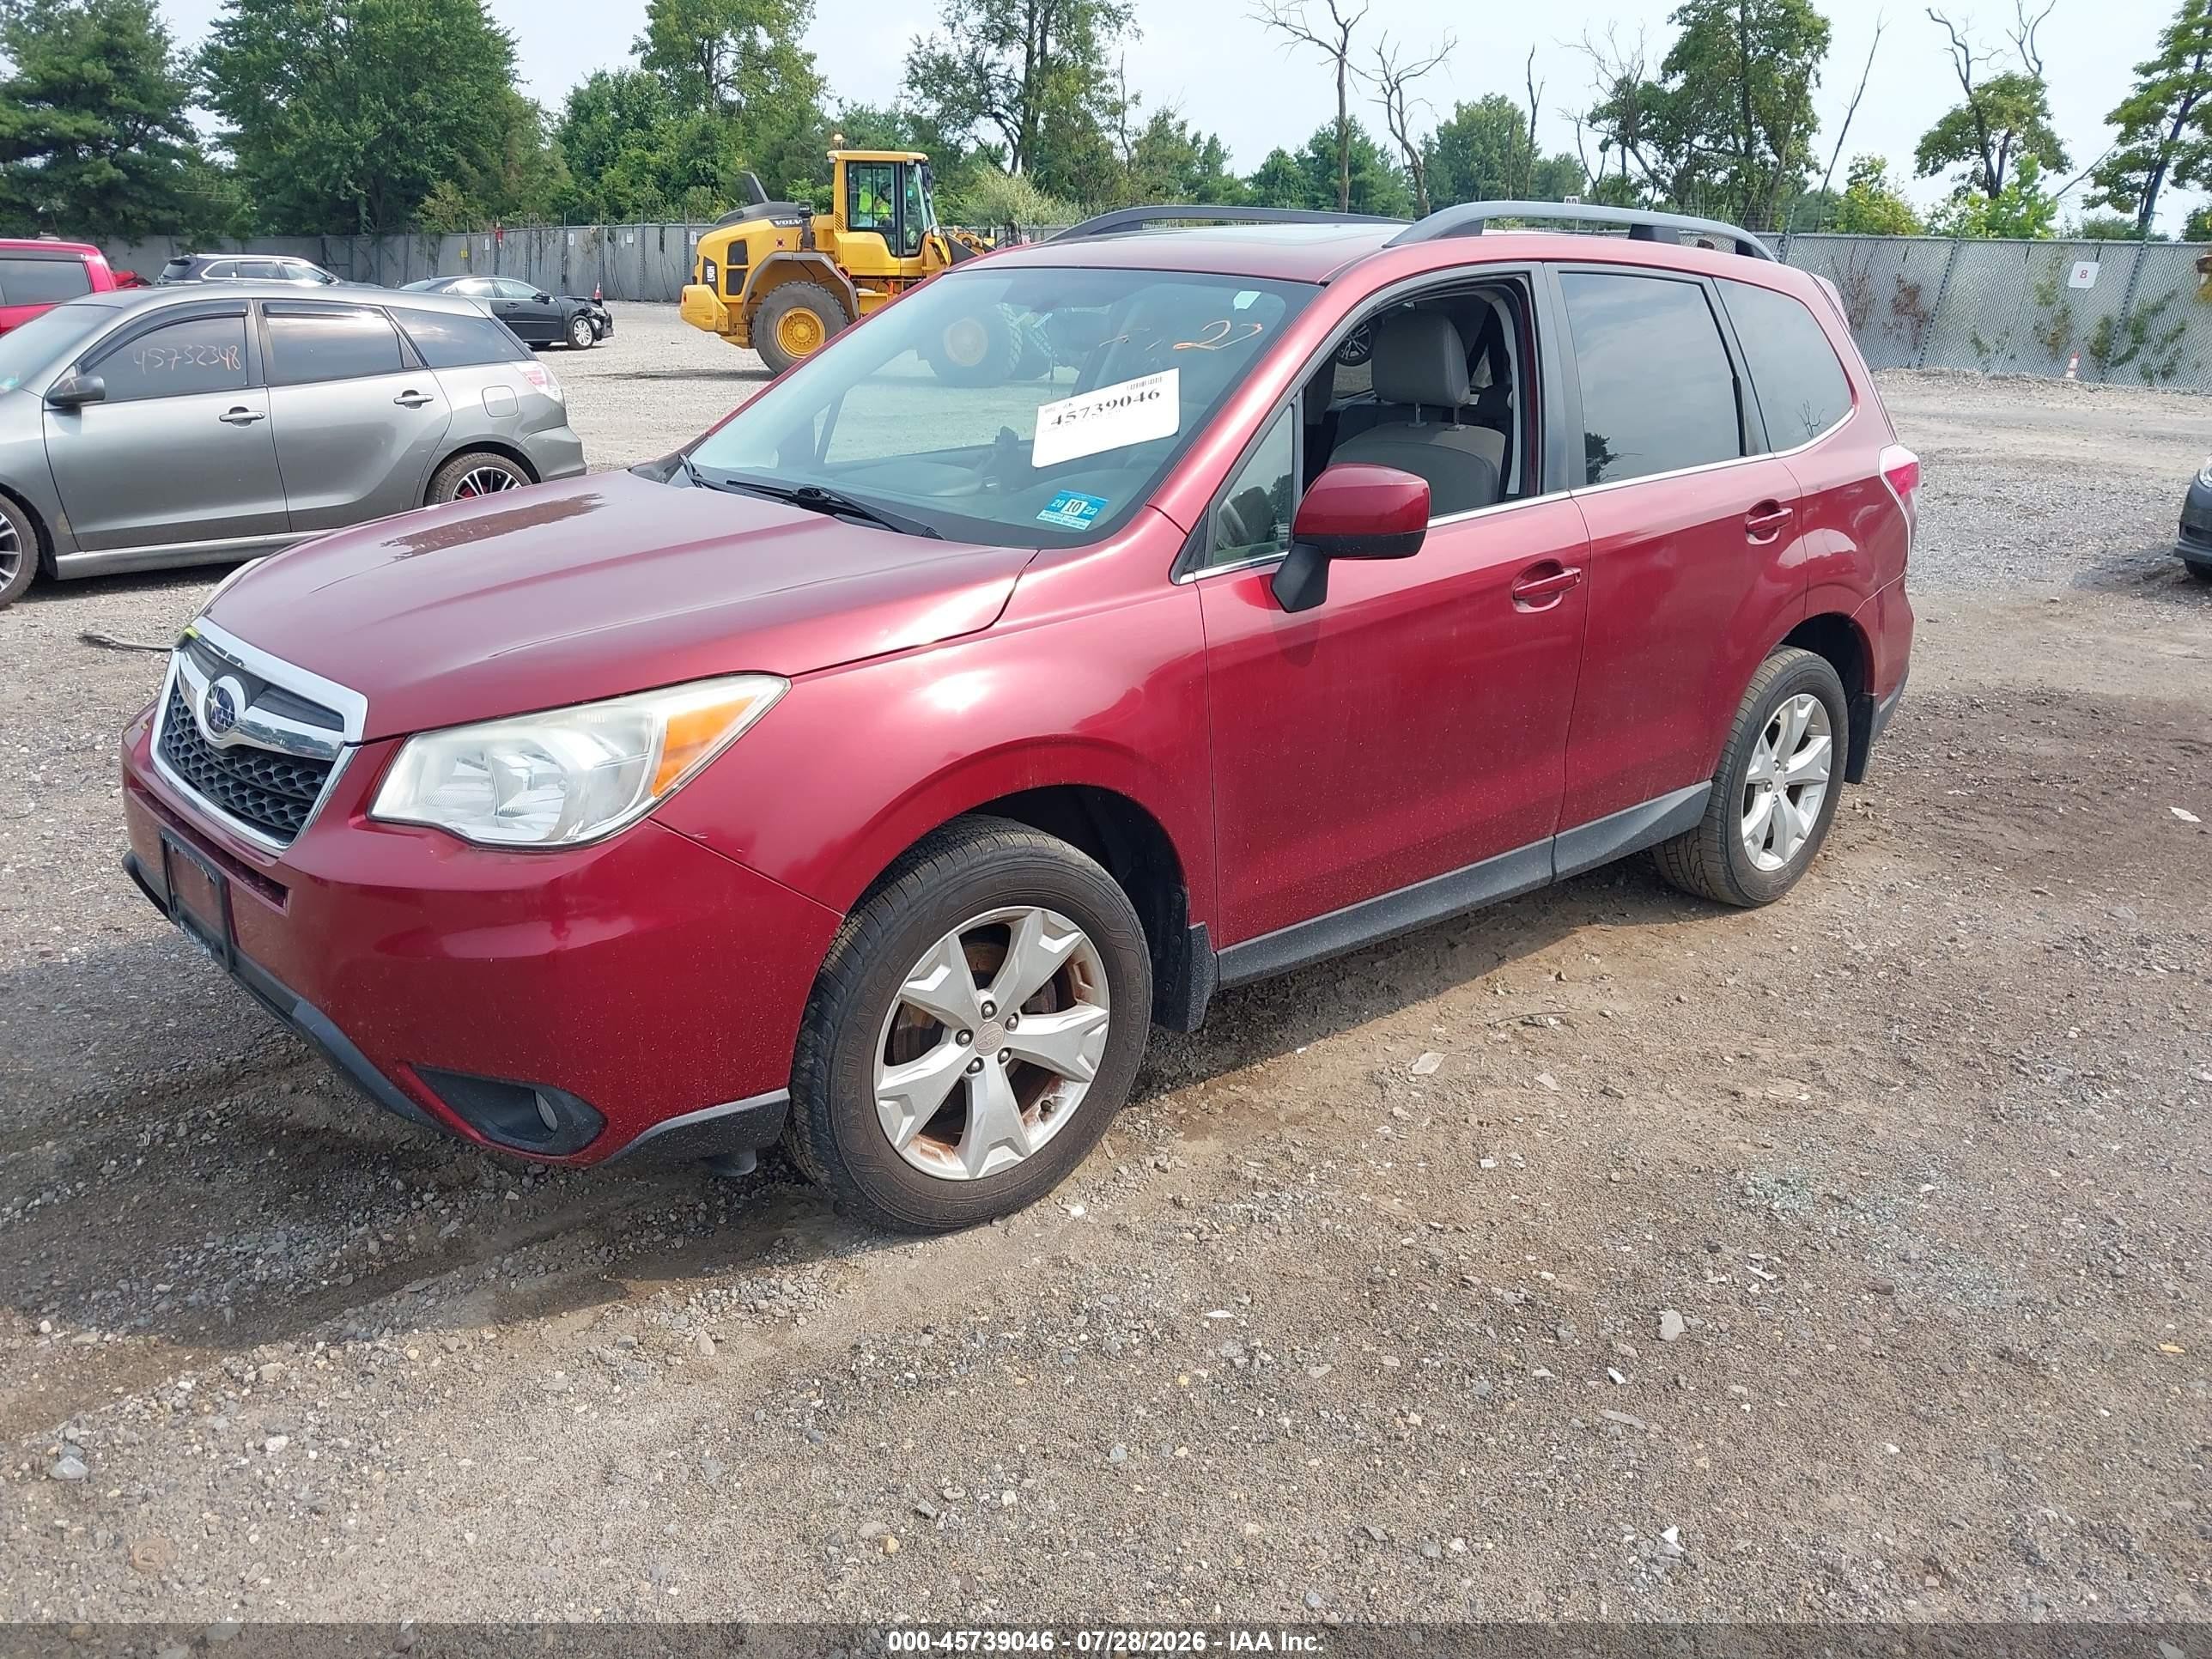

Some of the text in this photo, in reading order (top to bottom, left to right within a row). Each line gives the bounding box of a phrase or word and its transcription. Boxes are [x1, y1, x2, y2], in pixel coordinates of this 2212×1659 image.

[2080, 269, 2088, 279] 8
[133, 345, 240, 375] 45732348
[1050, 388, 1160, 426] 45739046
[1050, 499, 1098, 516] 20 10 22
